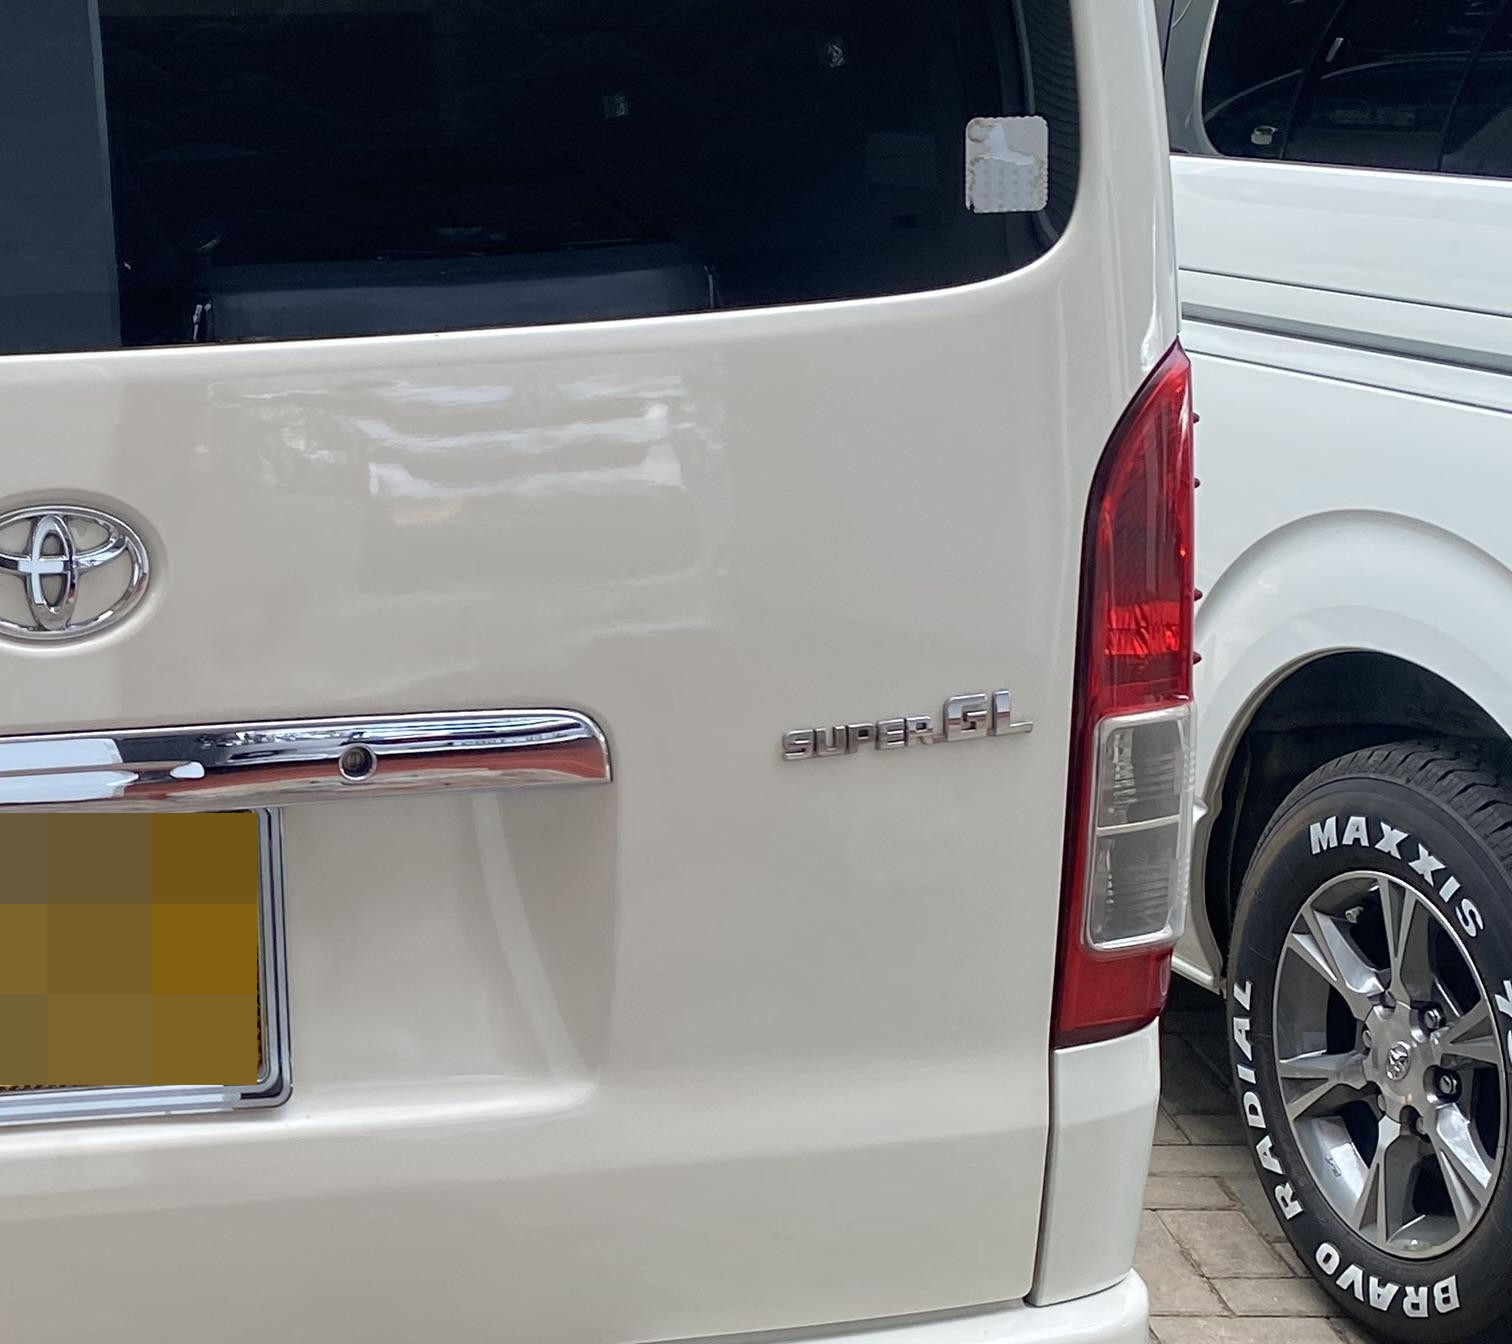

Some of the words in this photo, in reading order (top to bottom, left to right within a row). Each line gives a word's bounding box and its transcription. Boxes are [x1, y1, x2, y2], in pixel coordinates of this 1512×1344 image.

[782, 715, 934, 761] SUPER
[942, 688, 1034, 743] GL
[1309, 816, 1485, 938] MAXXIS
[1233, 979, 1304, 1221] RADIAL
[1315, 1242, 1461, 1318] BRAVO
